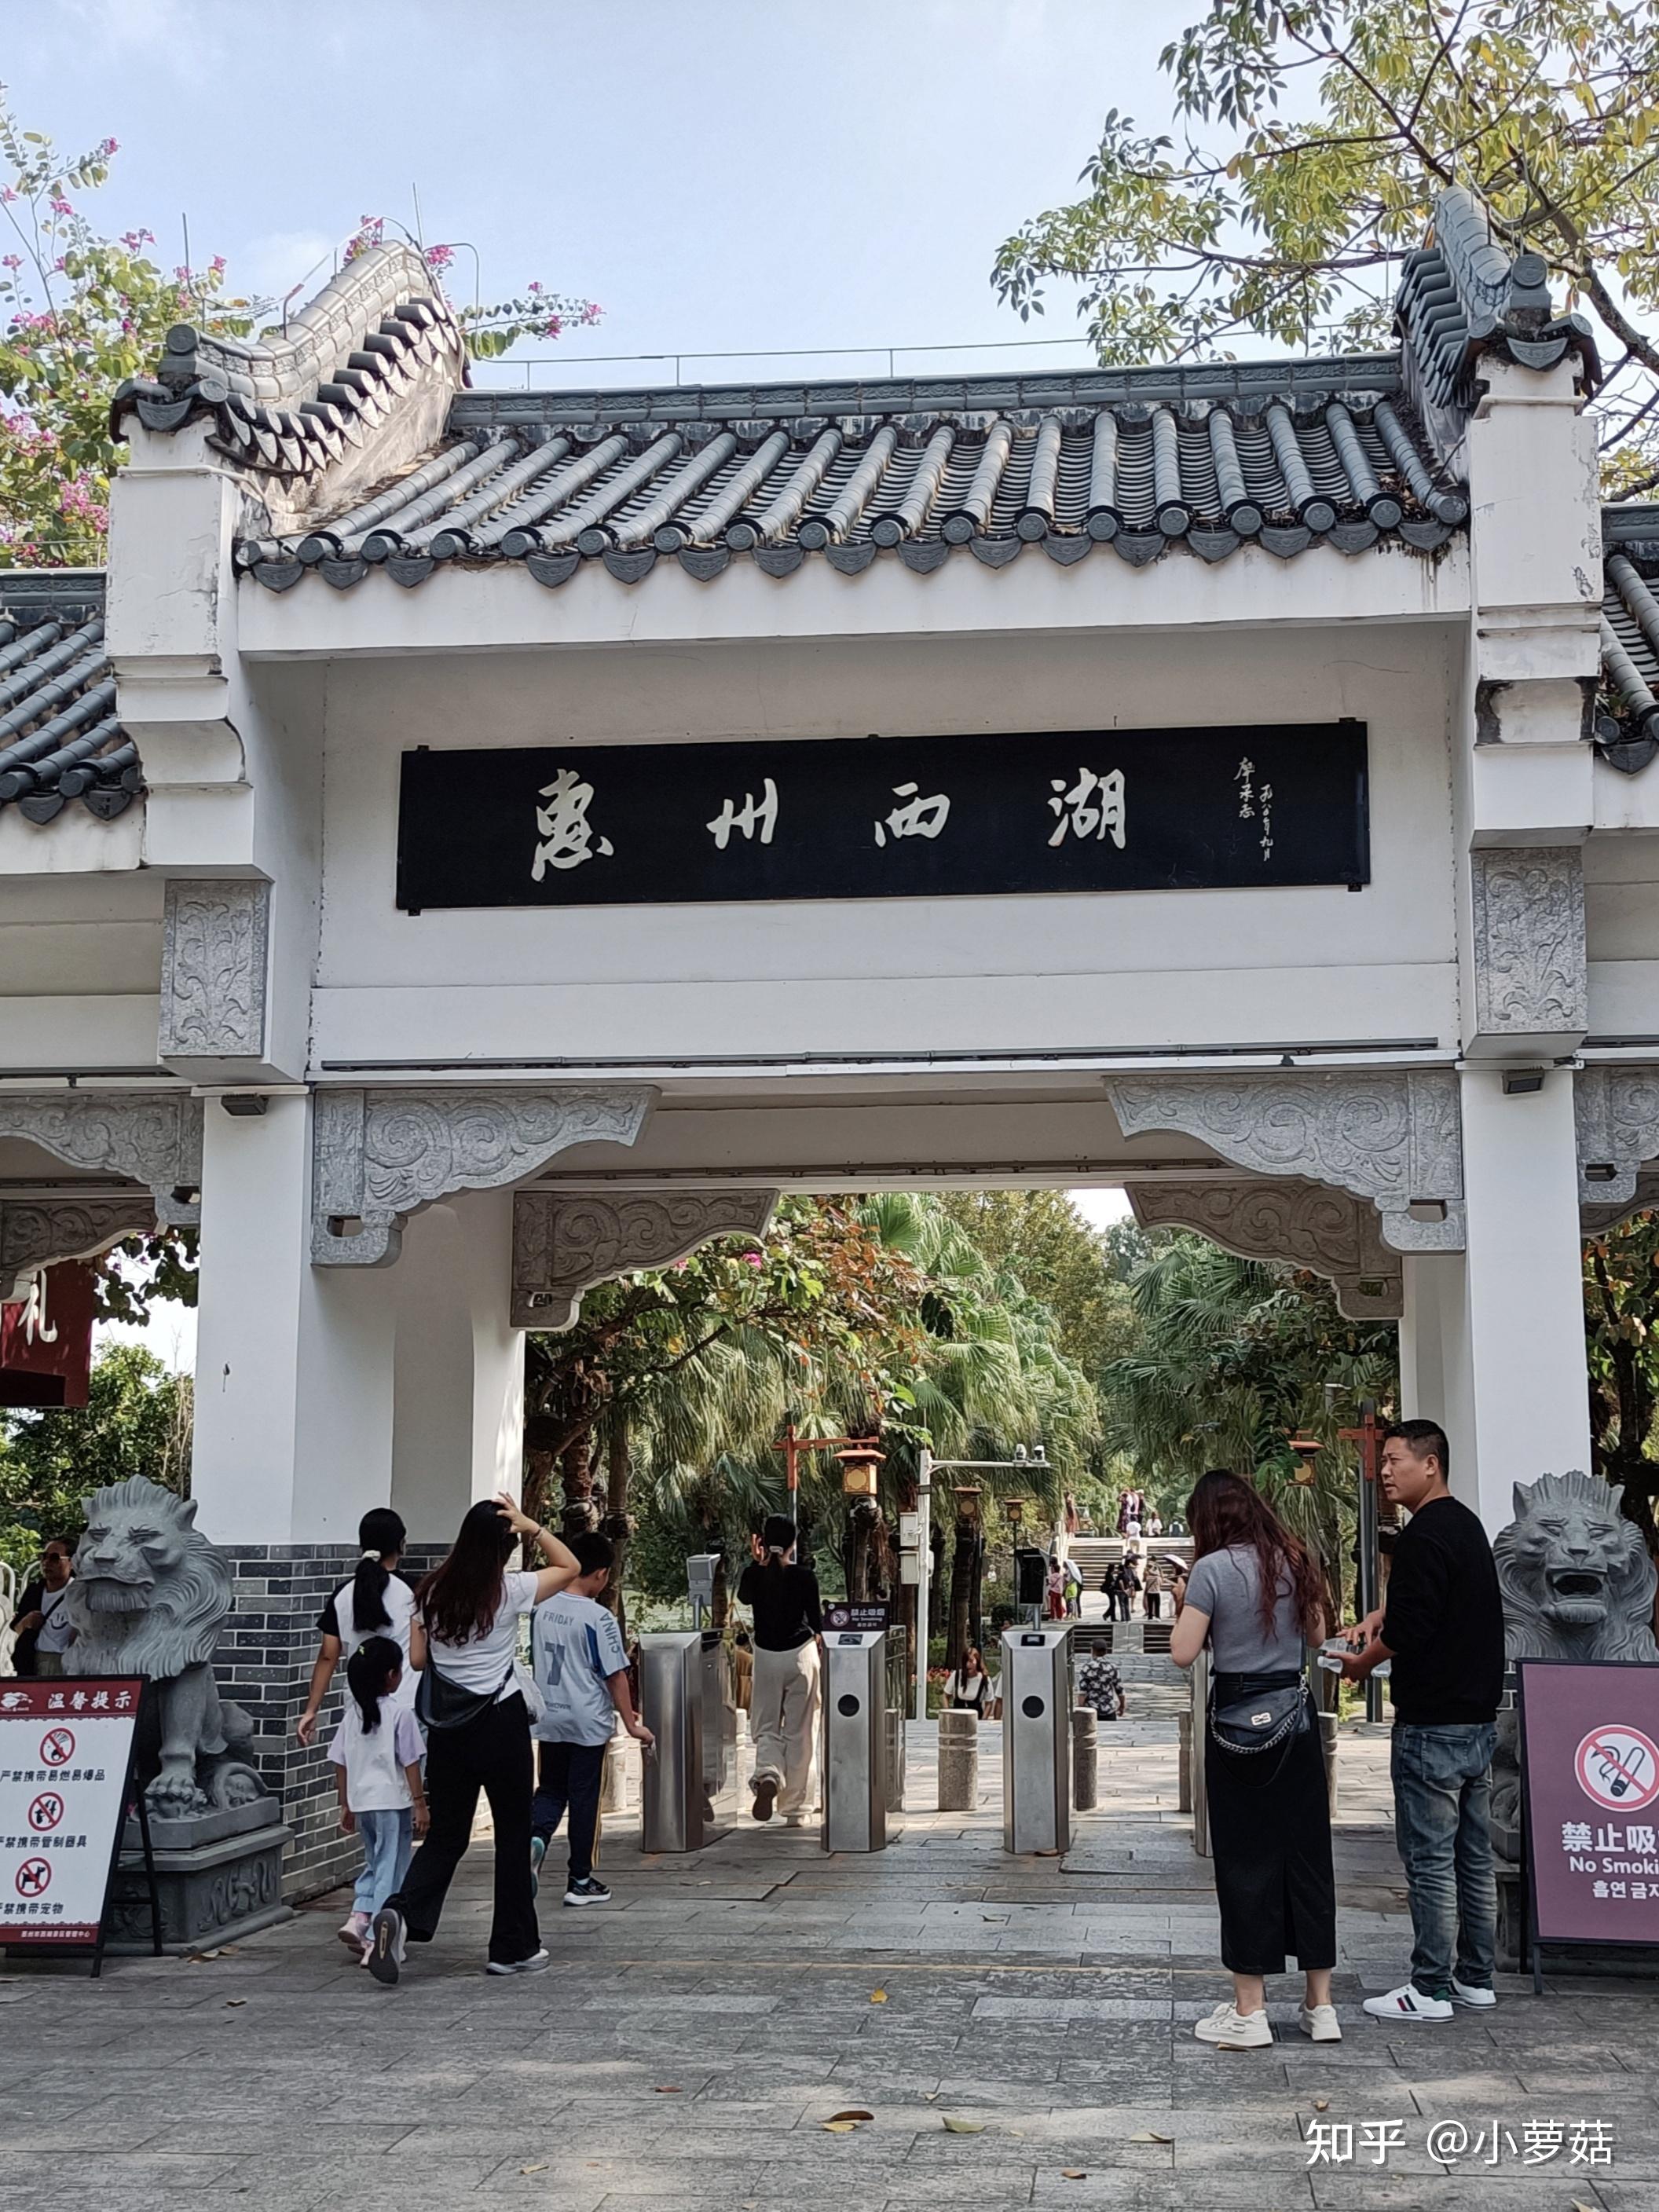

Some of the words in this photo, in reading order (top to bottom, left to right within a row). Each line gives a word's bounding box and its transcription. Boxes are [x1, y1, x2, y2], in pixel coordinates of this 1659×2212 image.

[531, 767, 1126, 882] 惠州西湖
[543, 1610, 575, 1627] FRIDAY
[599, 1612, 621, 1654] CHINA
[544, 1641, 566, 1686] 7
[48, 1690, 131, 1711] 温馨提示
[0, 1769, 105, 1782] 严禁携带易燃易爆品
[1562, 1821, 1659, 1854] 禁止吸
[1569, 1855, 1597, 1873] No
[1602, 1857, 1659, 1875] Smoki
[1592, 1880, 1627, 1899] 흡연
[0, 1903, 64, 1915] 禁携带宠物
